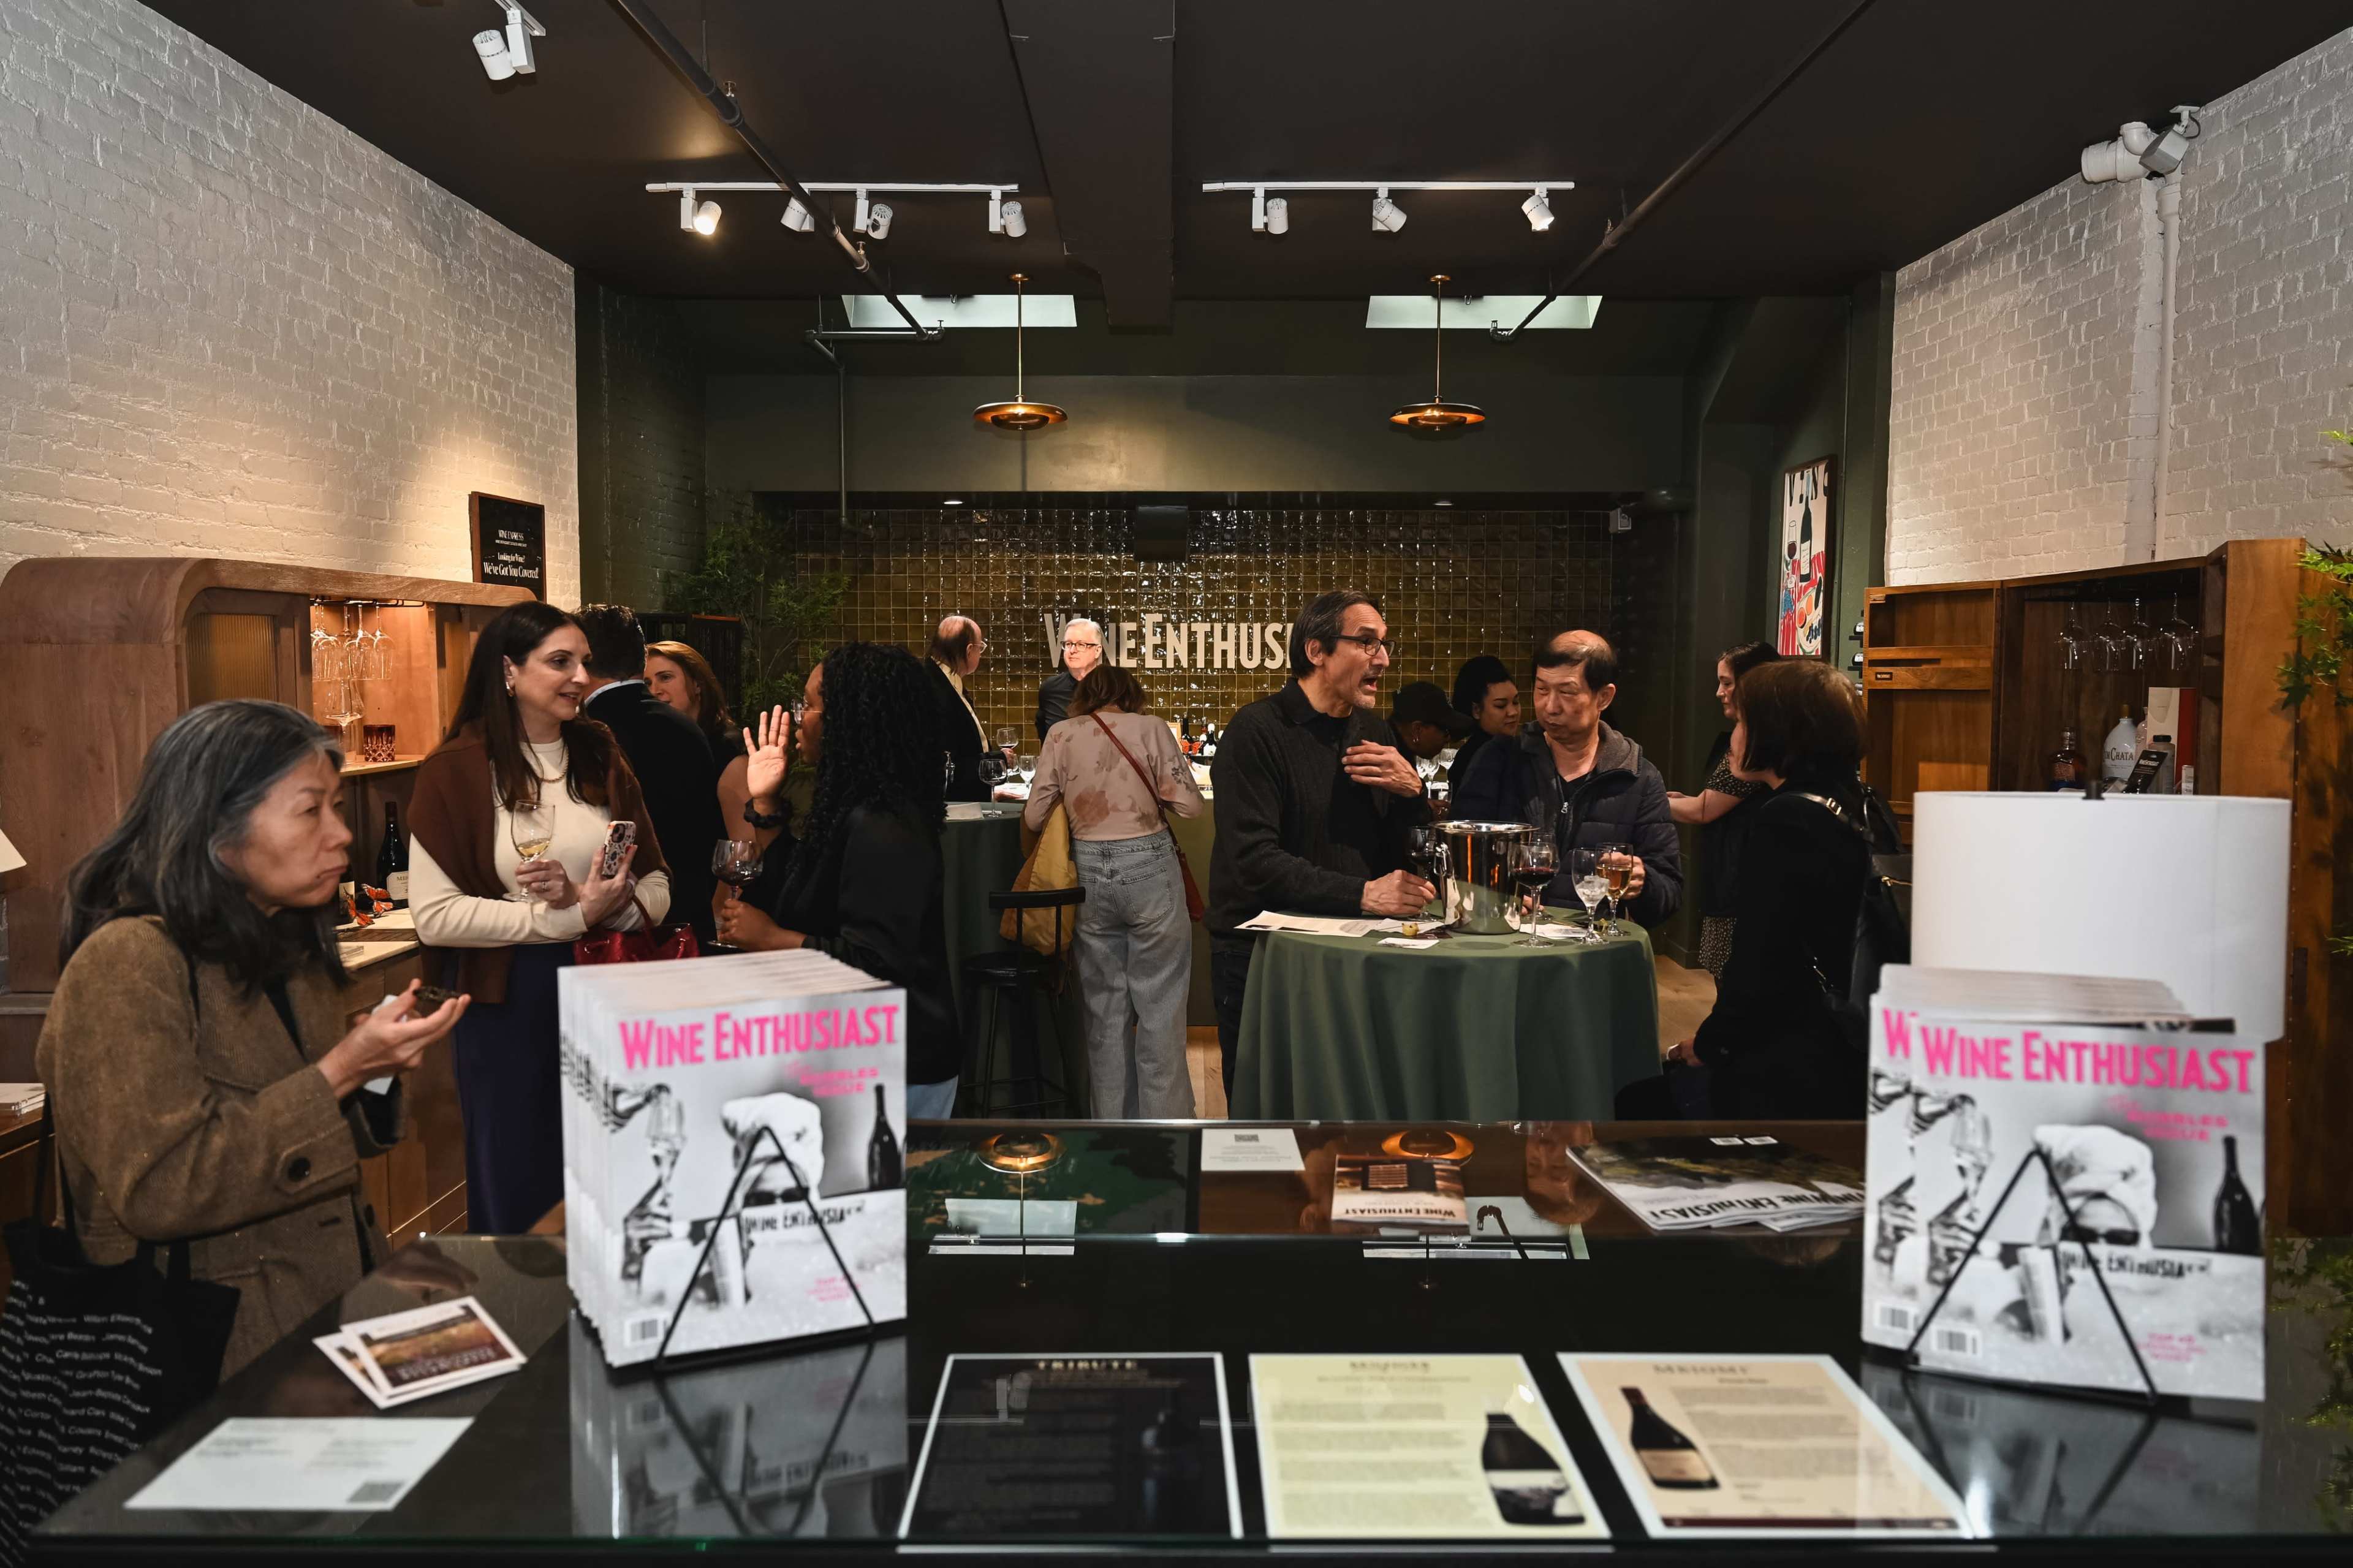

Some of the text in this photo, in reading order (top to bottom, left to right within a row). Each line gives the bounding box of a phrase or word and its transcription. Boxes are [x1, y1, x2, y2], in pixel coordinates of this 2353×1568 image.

[483, 562, 498, 575] We've
[499, 564, 509, 576] Got
[509, 565, 518, 577] You
[619, 1004, 900, 1070] WINE ENTHUSIAST
[1920, 1024, 2256, 1095] WINE ENTHUSIAST
[1424, 1208, 1456, 1218] WINE
[1650, 1195, 1781, 1219] ENTHUSIAST
